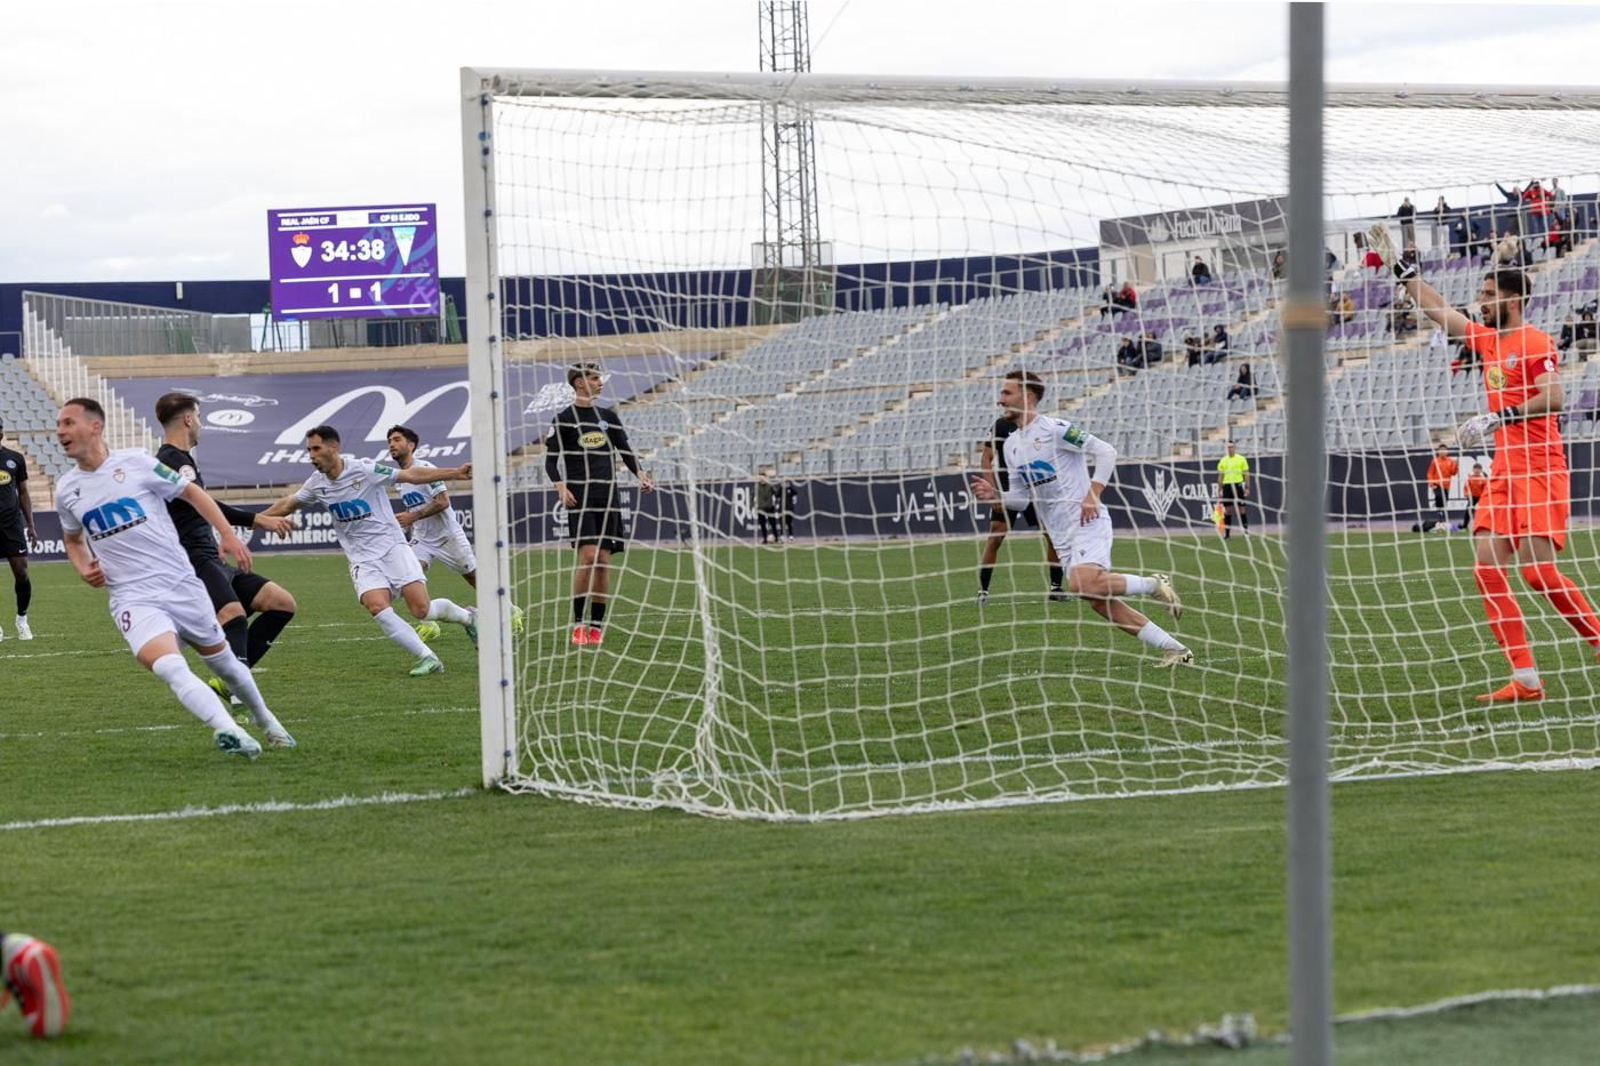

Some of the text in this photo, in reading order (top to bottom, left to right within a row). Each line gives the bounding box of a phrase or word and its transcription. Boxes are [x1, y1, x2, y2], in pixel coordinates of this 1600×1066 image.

[321, 239, 385, 262] 34:38
[328, 281, 381, 303] 1 1
